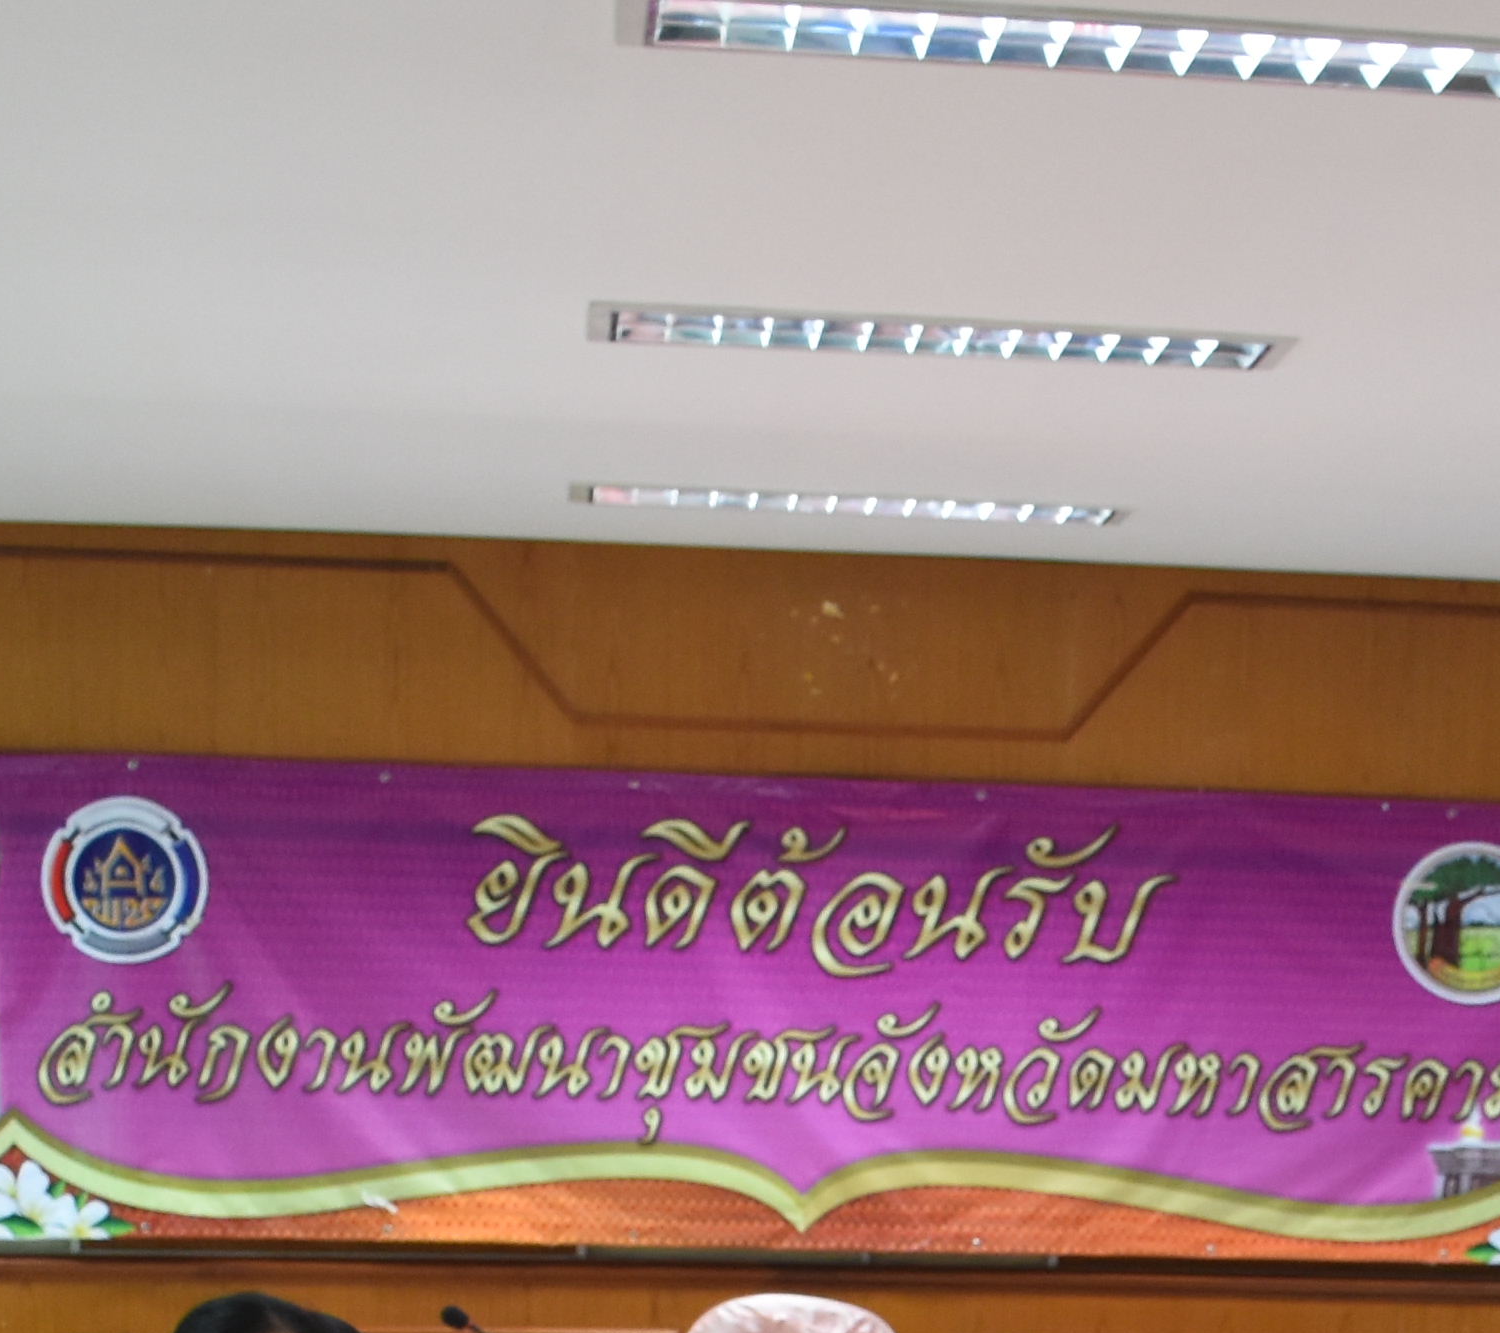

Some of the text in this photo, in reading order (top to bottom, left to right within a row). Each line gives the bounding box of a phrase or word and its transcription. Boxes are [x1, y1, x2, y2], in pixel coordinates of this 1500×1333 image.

[466, 812, 1177, 978] ยินดีต้อนรับ
